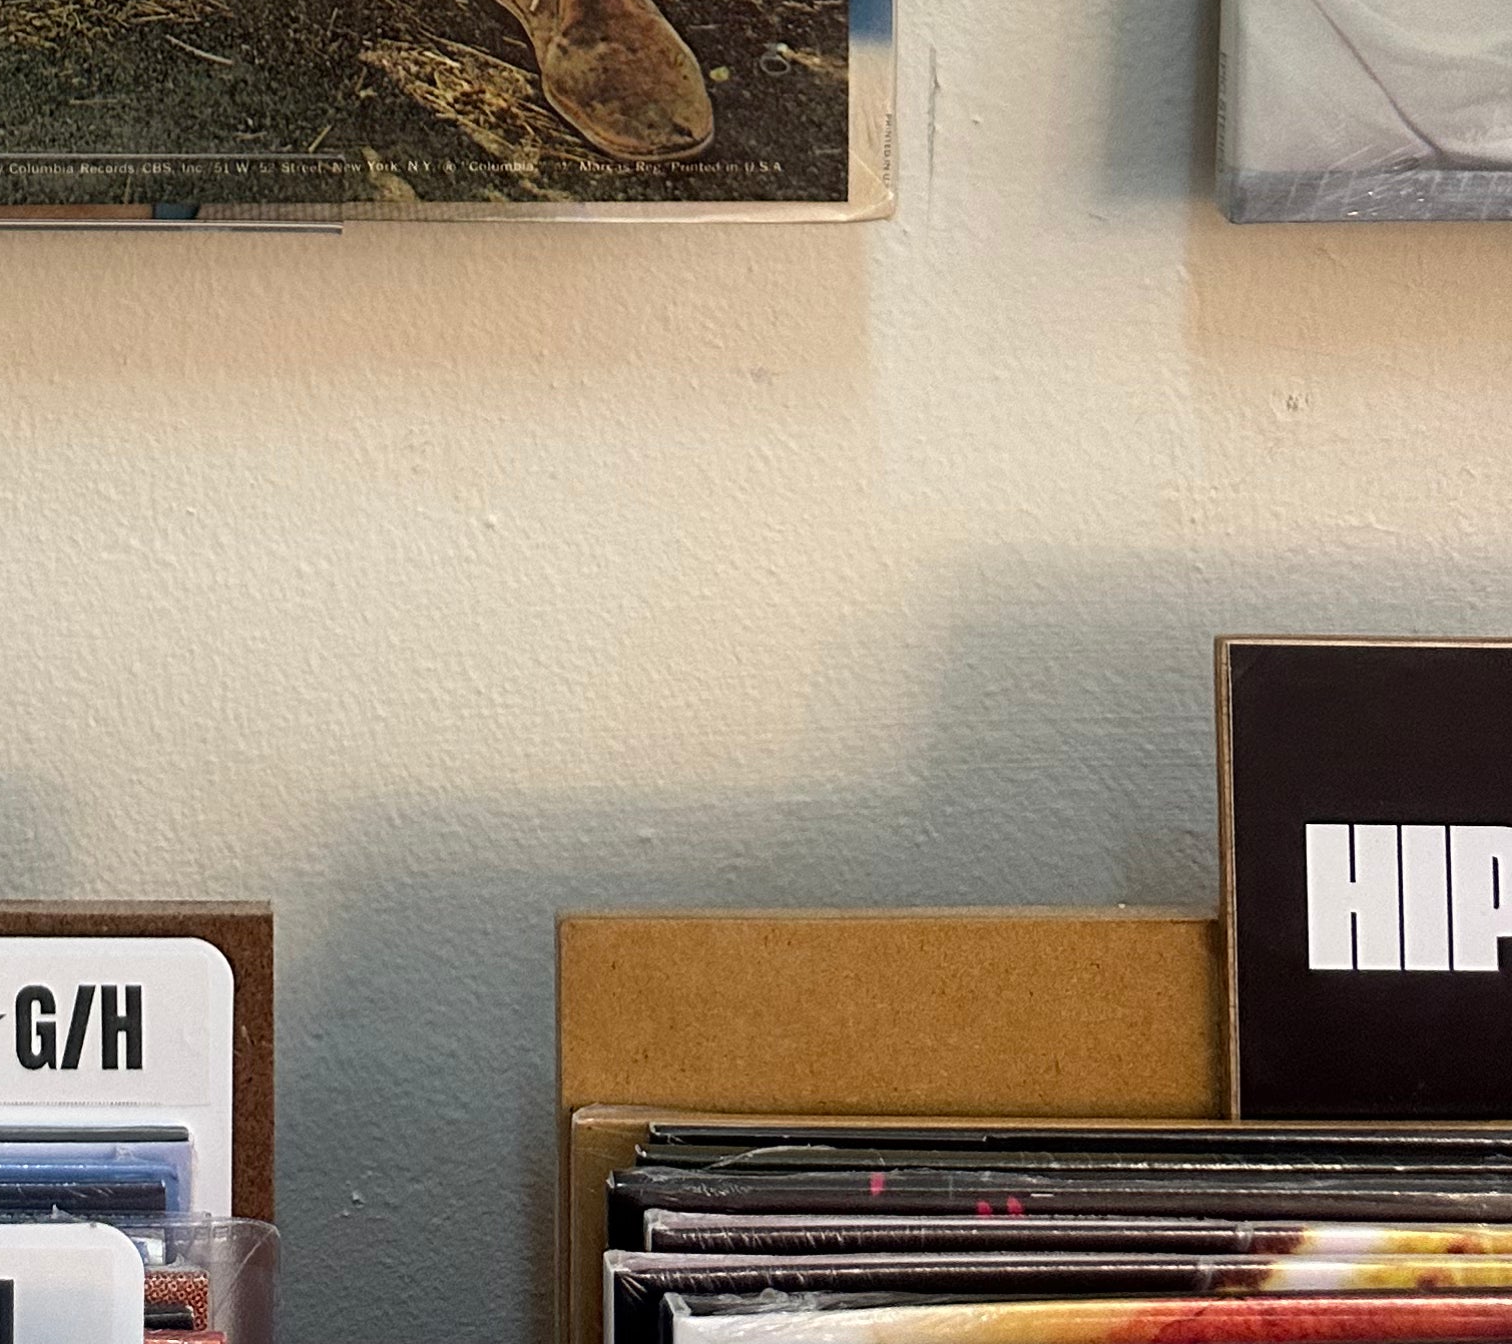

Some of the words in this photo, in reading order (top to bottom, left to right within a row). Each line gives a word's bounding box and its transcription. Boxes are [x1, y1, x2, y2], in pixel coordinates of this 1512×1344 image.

[8, 162, 74, 175] Columbia
[332, 160, 361, 173] New
[670, 160, 719, 173] Printed
[1305, 822, 1512, 973] HIP
[14, 983, 144, 1073] G/H
